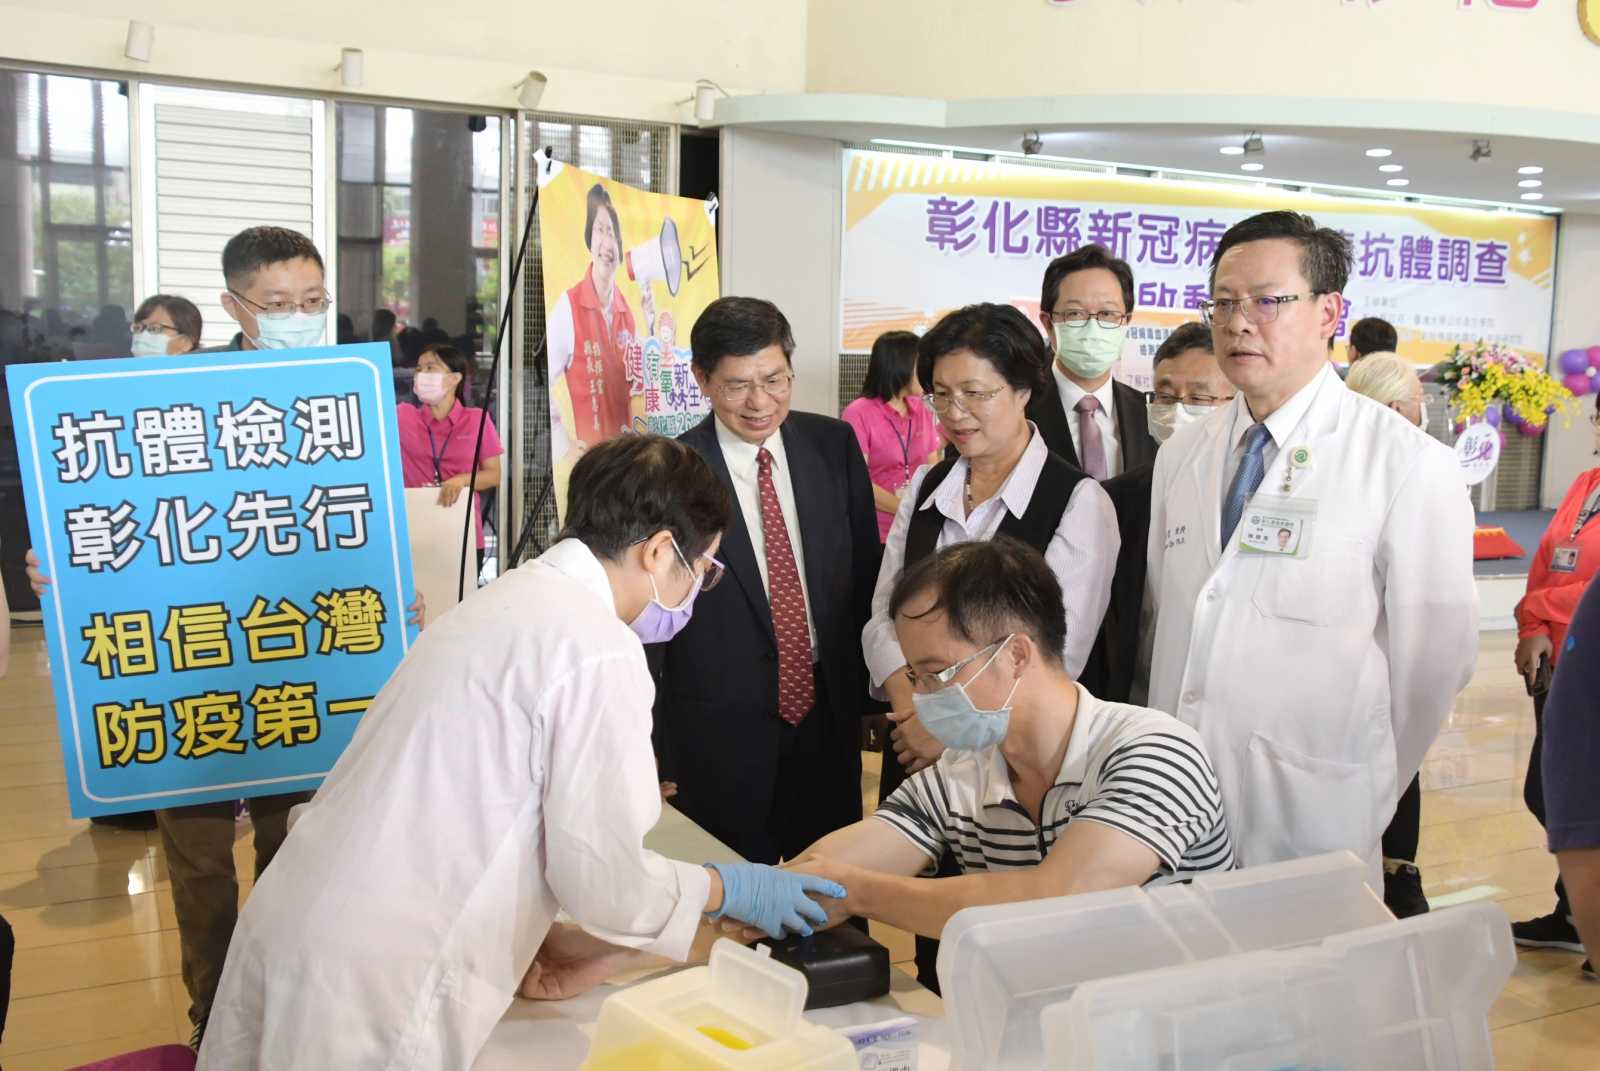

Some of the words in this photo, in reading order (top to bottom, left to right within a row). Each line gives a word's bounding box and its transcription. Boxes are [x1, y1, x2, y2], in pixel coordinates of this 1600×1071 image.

[53, 392, 364, 482] 抗體檢測
[66, 483, 372, 573] 彰化先行
[80, 585, 387, 679] 相信台灣
[94, 682, 378, 769] 防疫第一
